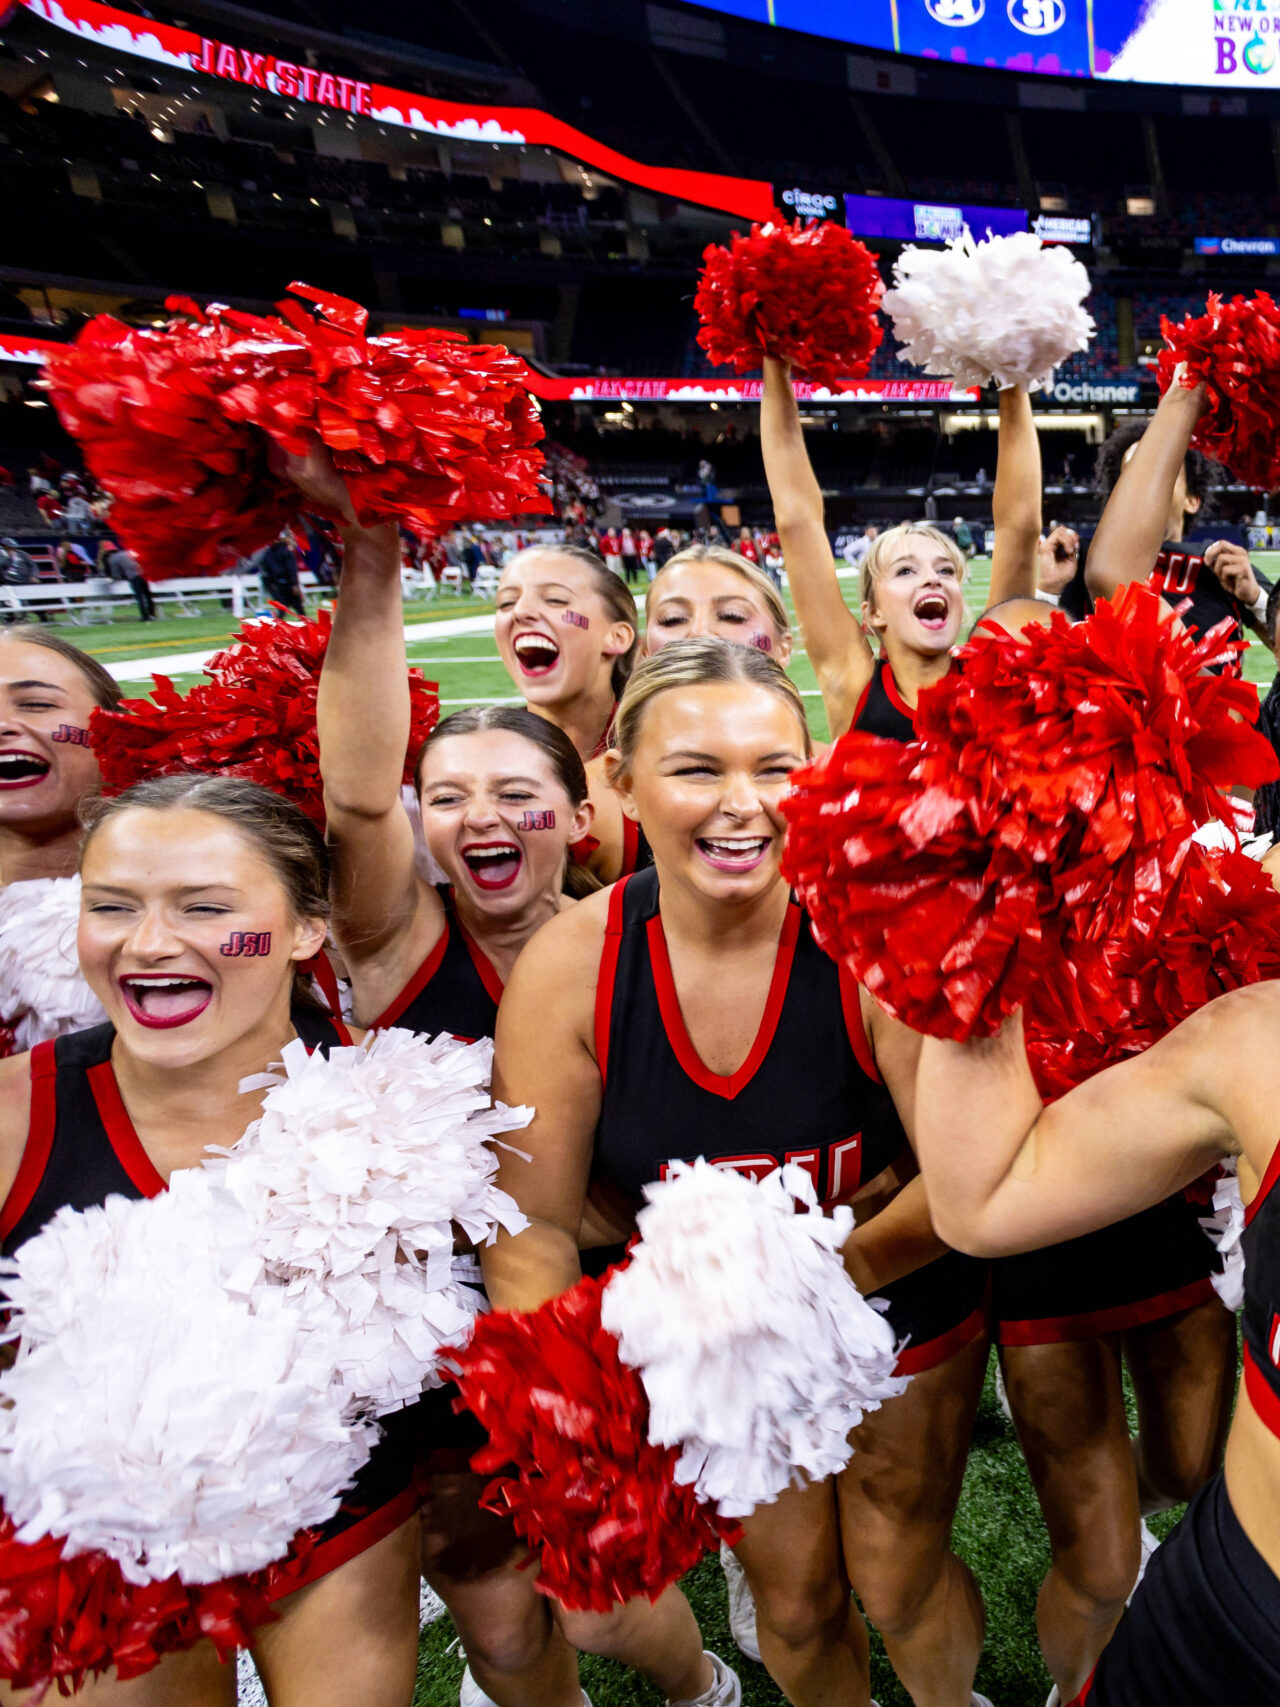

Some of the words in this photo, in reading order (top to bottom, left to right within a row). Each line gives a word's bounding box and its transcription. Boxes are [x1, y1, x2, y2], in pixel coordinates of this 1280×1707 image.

[1213, 15, 1253, 32] NEW
[190, 37, 268, 90] JAX
[274, 59, 373, 116] STATE
[1220, 238, 1276, 254] Chevron
[1053, 381, 1138, 403] Ochsner
[561, 609, 589, 631] JSU
[517, 809, 556, 832] JSU
[219, 931, 272, 958] JSU
